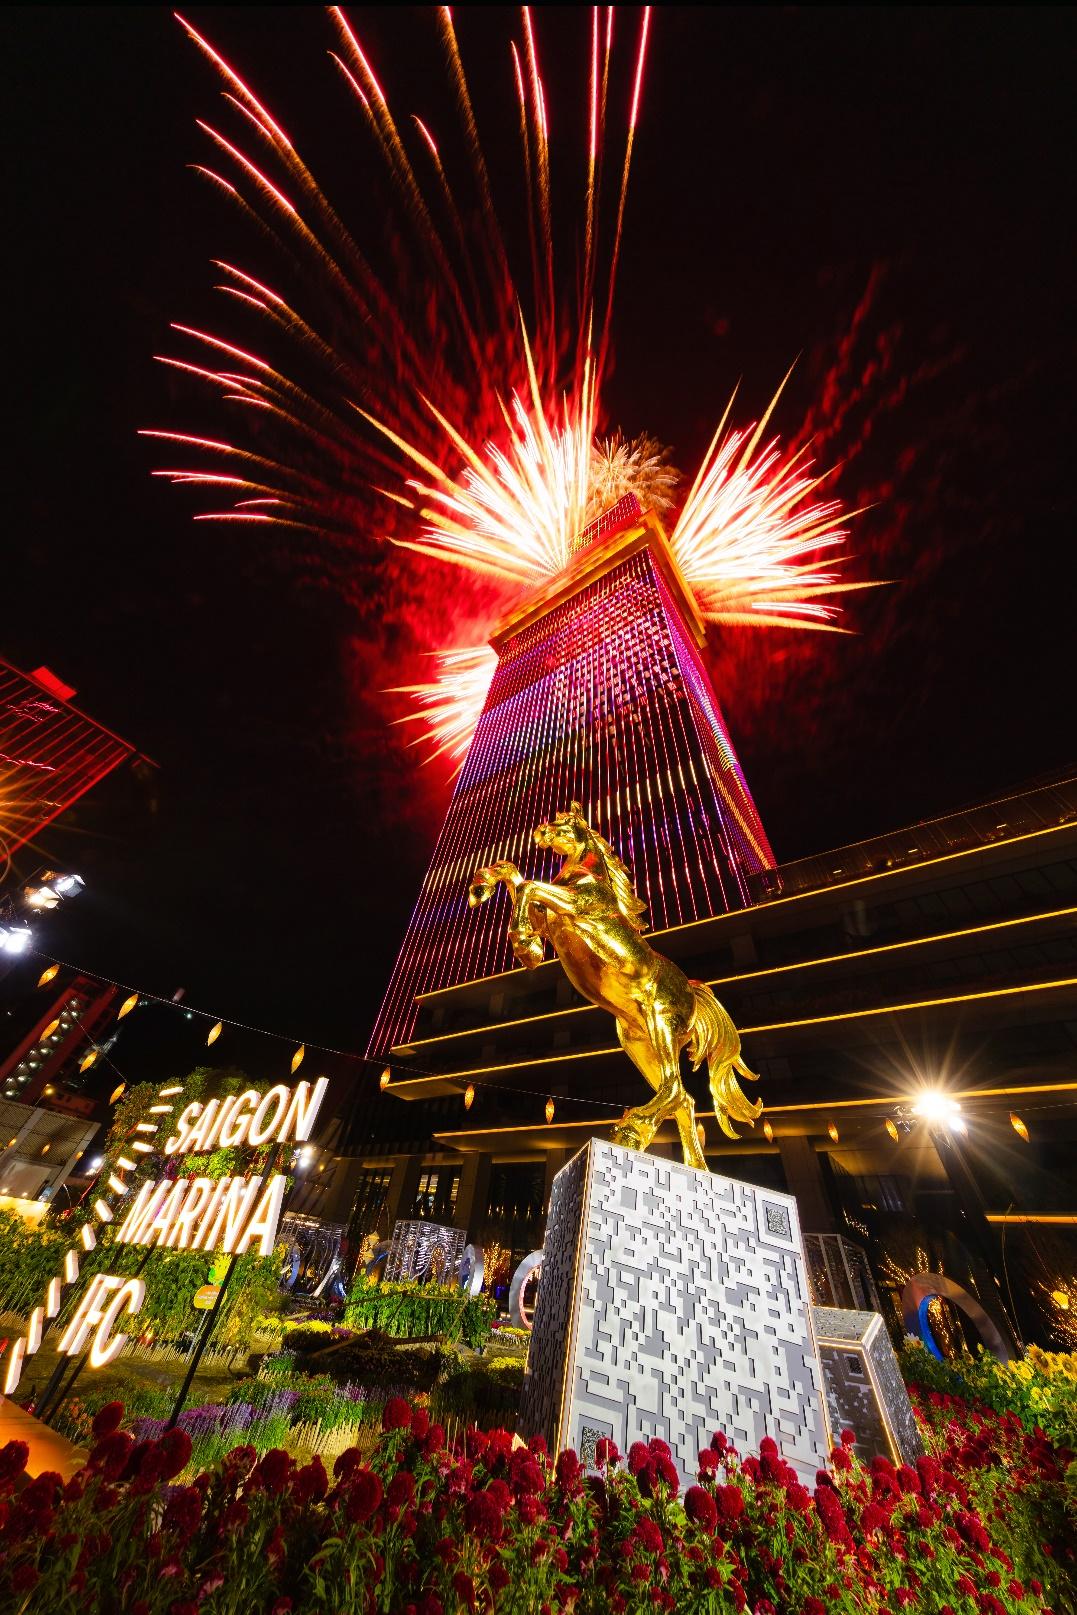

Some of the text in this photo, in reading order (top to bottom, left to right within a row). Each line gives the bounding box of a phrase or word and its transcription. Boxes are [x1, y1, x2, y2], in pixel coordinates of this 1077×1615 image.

[165, 1077, 329, 1154] SAIGON
[115, 1174, 287, 1256] MARINA
[58, 1273, 146, 1368] IFC
